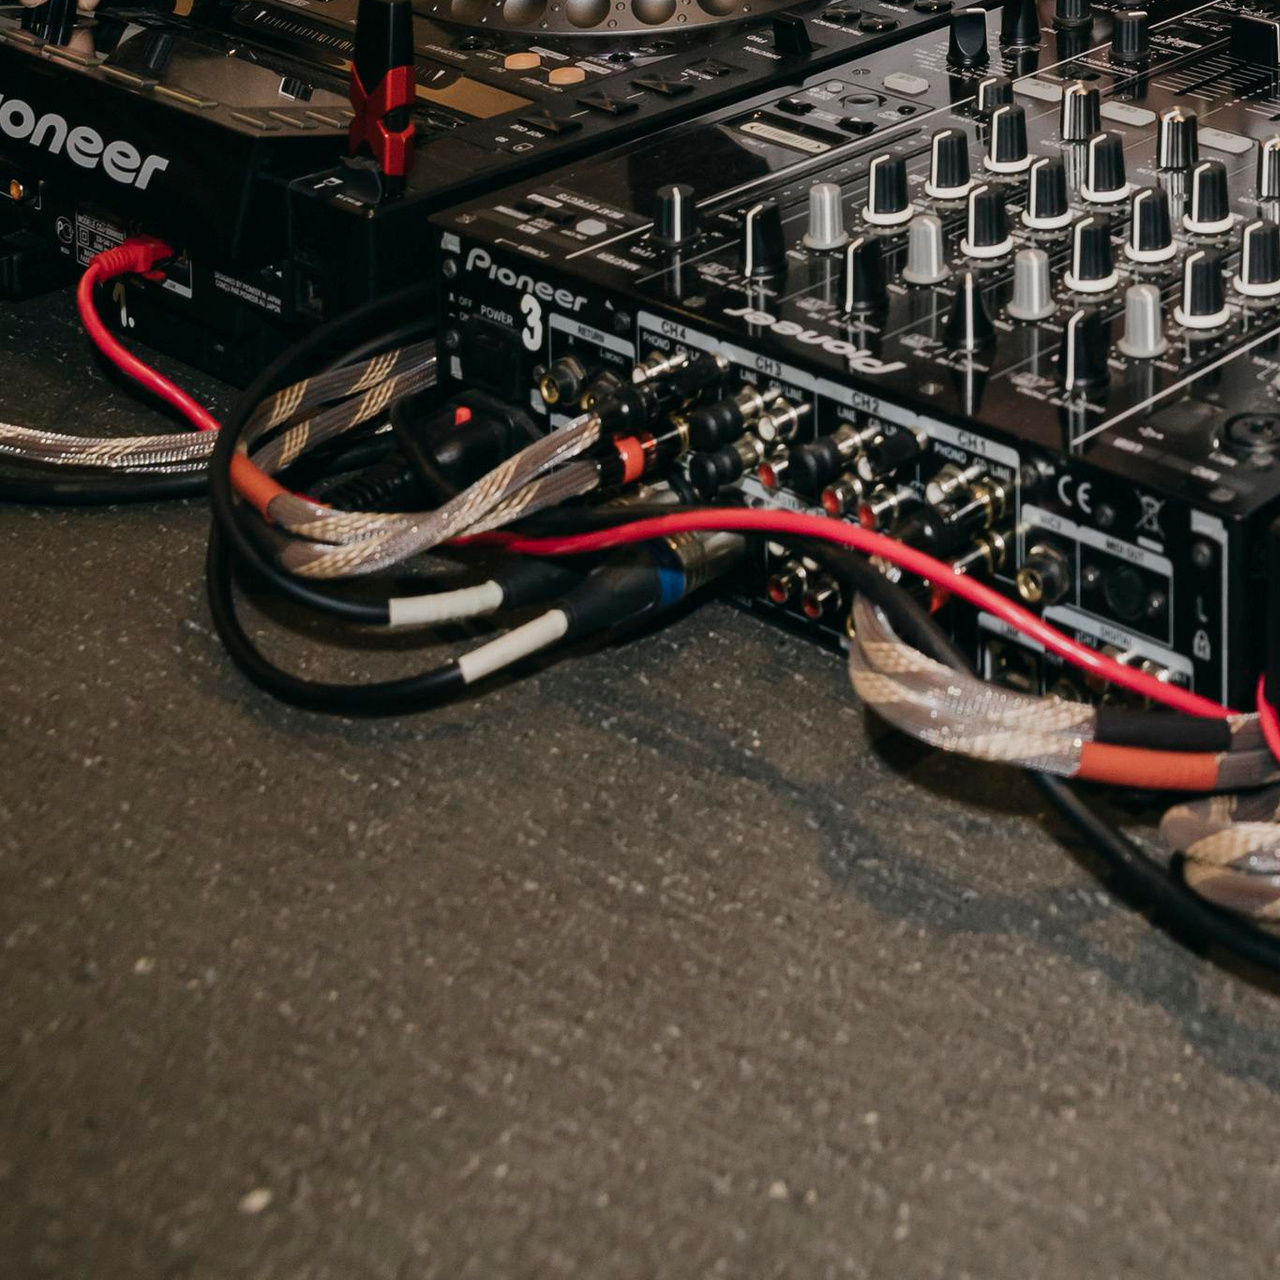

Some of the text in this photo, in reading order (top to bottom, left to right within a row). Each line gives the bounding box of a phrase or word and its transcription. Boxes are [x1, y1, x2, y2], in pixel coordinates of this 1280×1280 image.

[0, 94, 169, 190] oneer
[465, 247, 588, 312] Pioneer
[480, 304, 513, 326] POWER
[520, 293, 543, 351] 3
